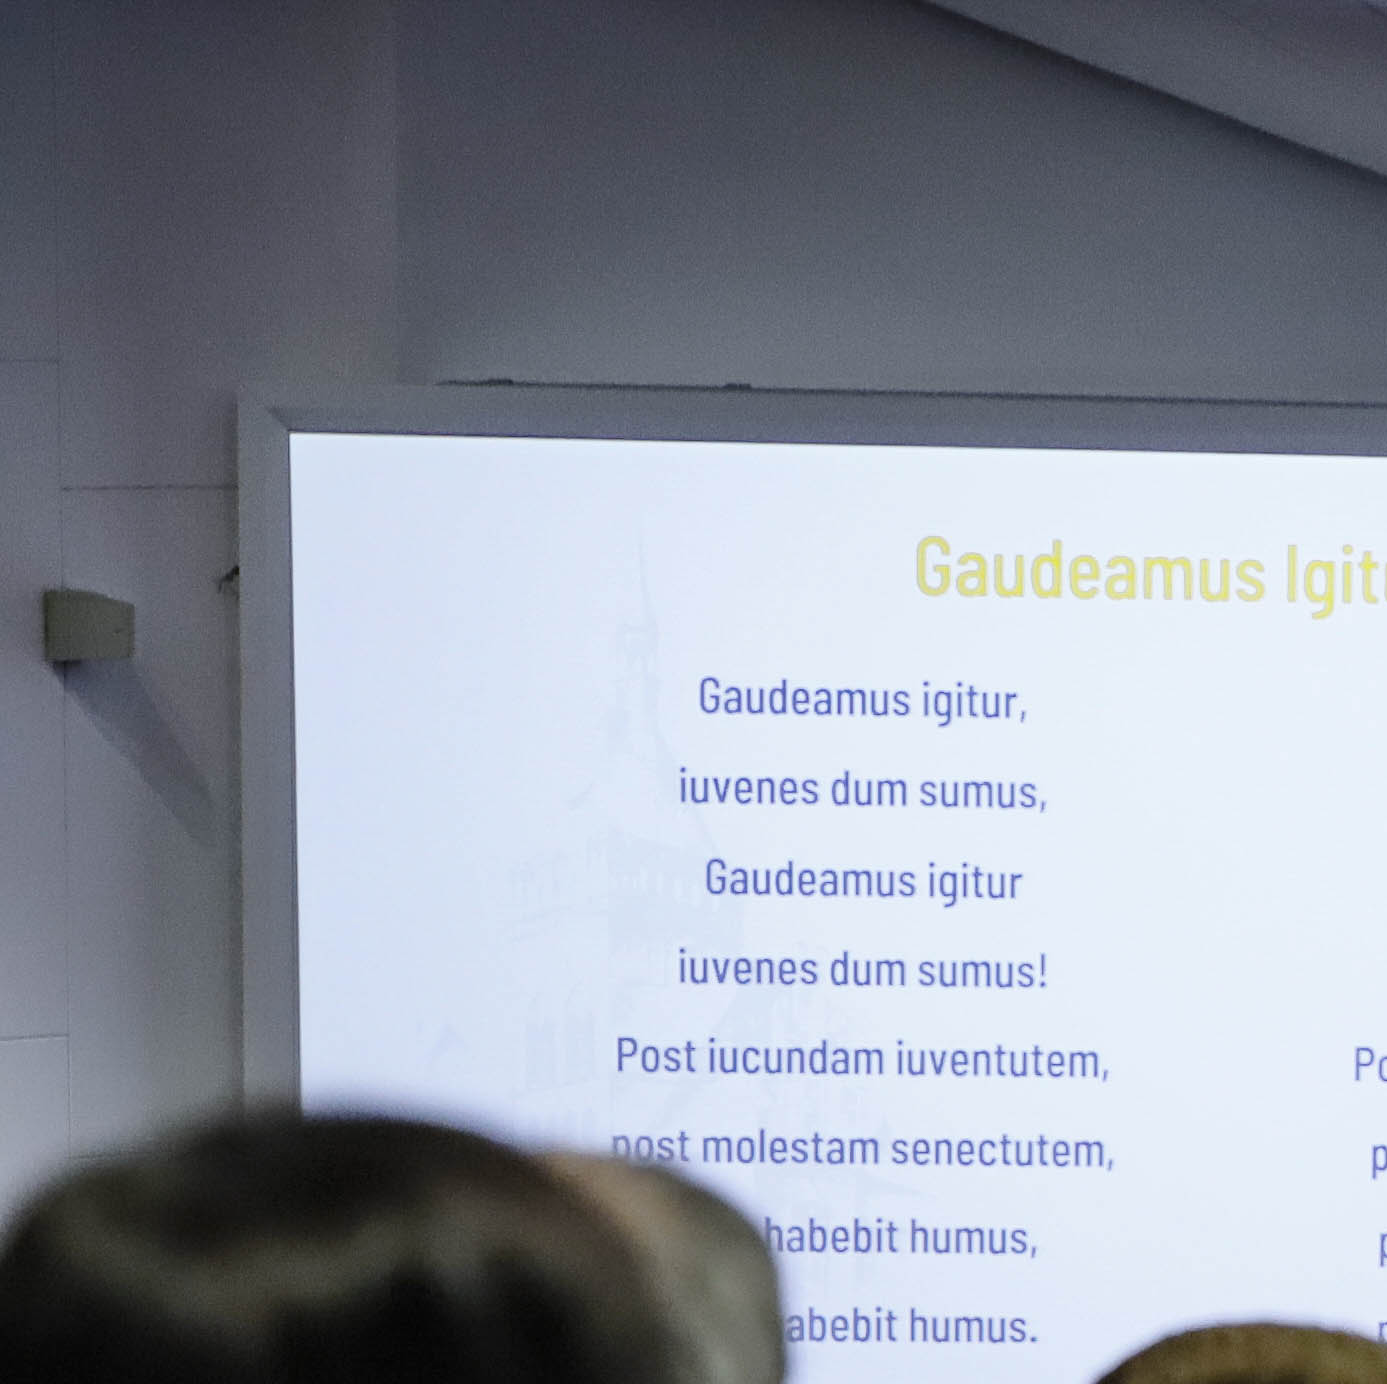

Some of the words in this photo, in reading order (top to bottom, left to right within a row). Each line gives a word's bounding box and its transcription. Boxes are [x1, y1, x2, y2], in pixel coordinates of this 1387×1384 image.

[916, 535, 1265, 602] Gaudeamus
[699, 676, 911, 717] Gaudeamus
[922, 680, 1026, 728] igitur,
[679, 766, 819, 806] iuvenes
[831, 770, 907, 807] dum
[919, 780, 1046, 812] sumus,
[706, 857, 916, 898] Gaudeamus
[928, 861, 1023, 909] igitur
[679, 947, 818, 986] iuvenes
[830, 950, 906, 987] dum
[918, 953, 1047, 989] sumus!
[617, 1036, 697, 1073] Post
[708, 1036, 884, 1076] iucundam
[897, 1039, 1109, 1081] iuventutem,
[612, 1130, 689, 1163] post
[702, 1127, 879, 1165] molestam
[891, 1134, 1113, 1171] senectutem,
[762, 1216, 899, 1254] habebit
[910, 1218, 1037, 1259] humus,
[784, 1306, 899, 1343] abebit
[910, 1307, 1038, 1344] humus.
